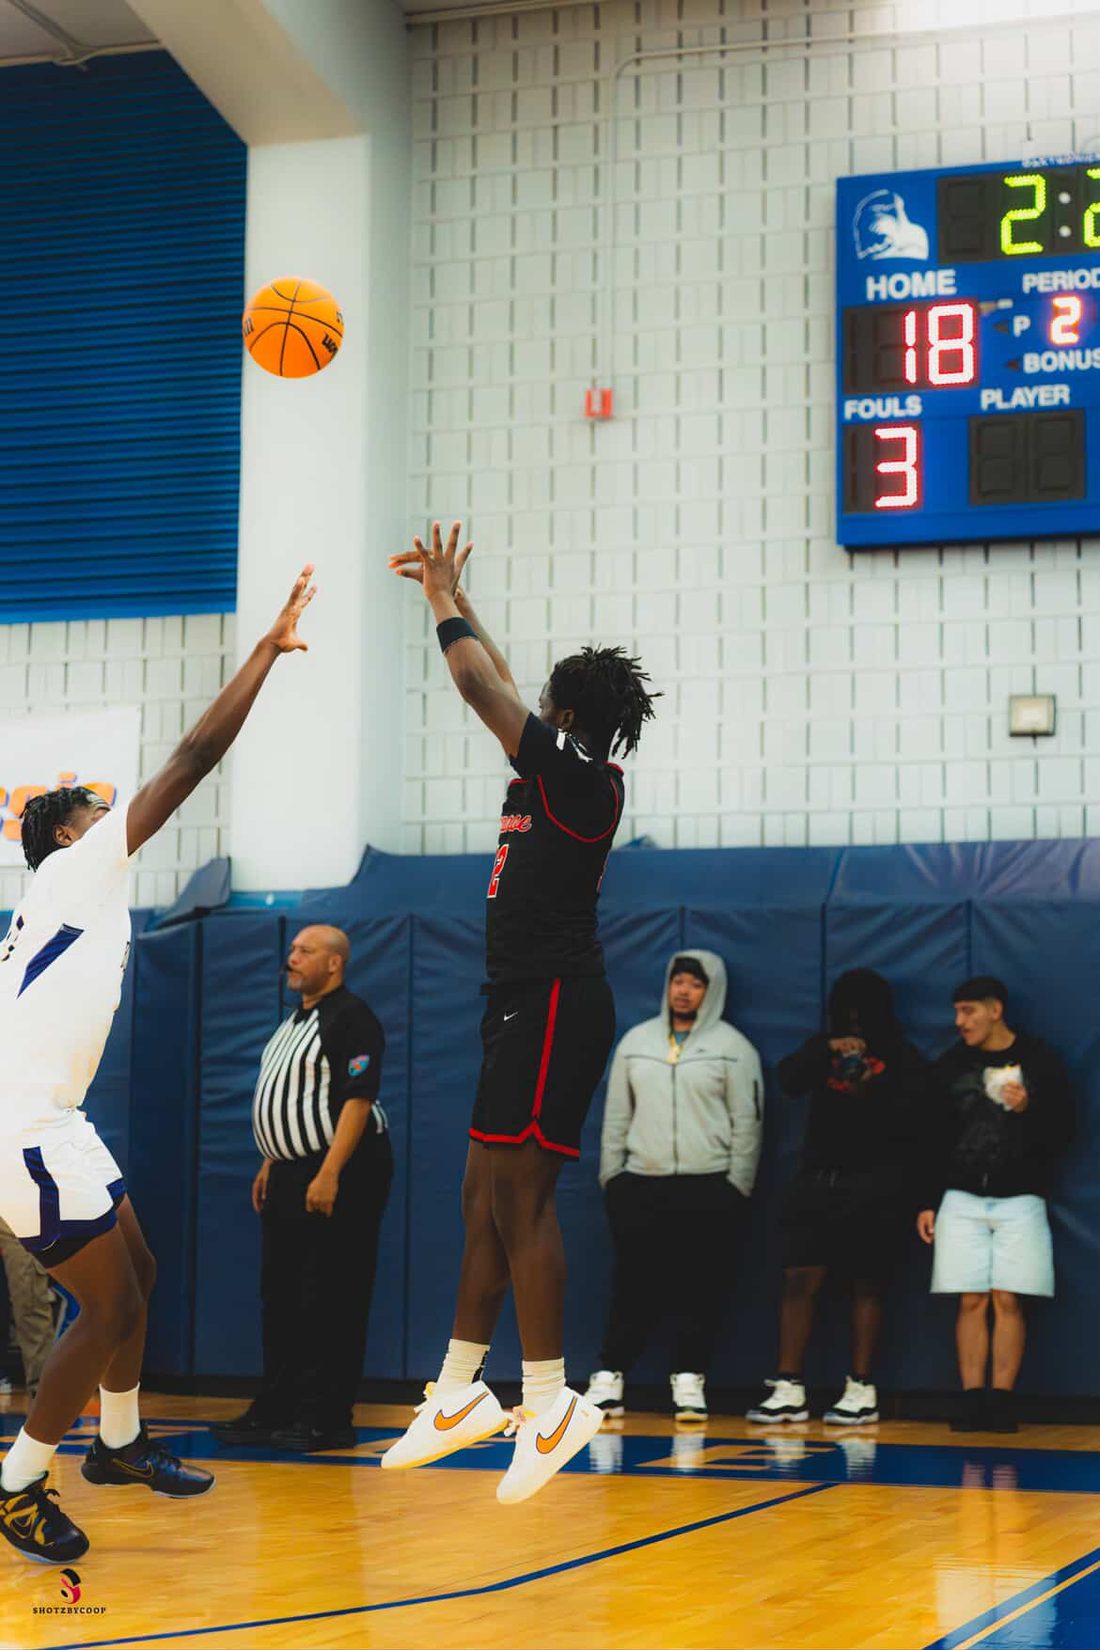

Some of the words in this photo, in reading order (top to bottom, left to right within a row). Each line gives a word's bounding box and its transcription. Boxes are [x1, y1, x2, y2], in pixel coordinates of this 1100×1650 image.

[866, 268, 957, 301] HOME
[1013, 314, 1031, 338] P
[1050, 296, 1081, 345] 2
[905, 303, 974, 385] 18
[844, 394, 922, 420] FOULS
[980, 383, 1070, 411] PLAYER
[874, 427, 918, 508] 3
